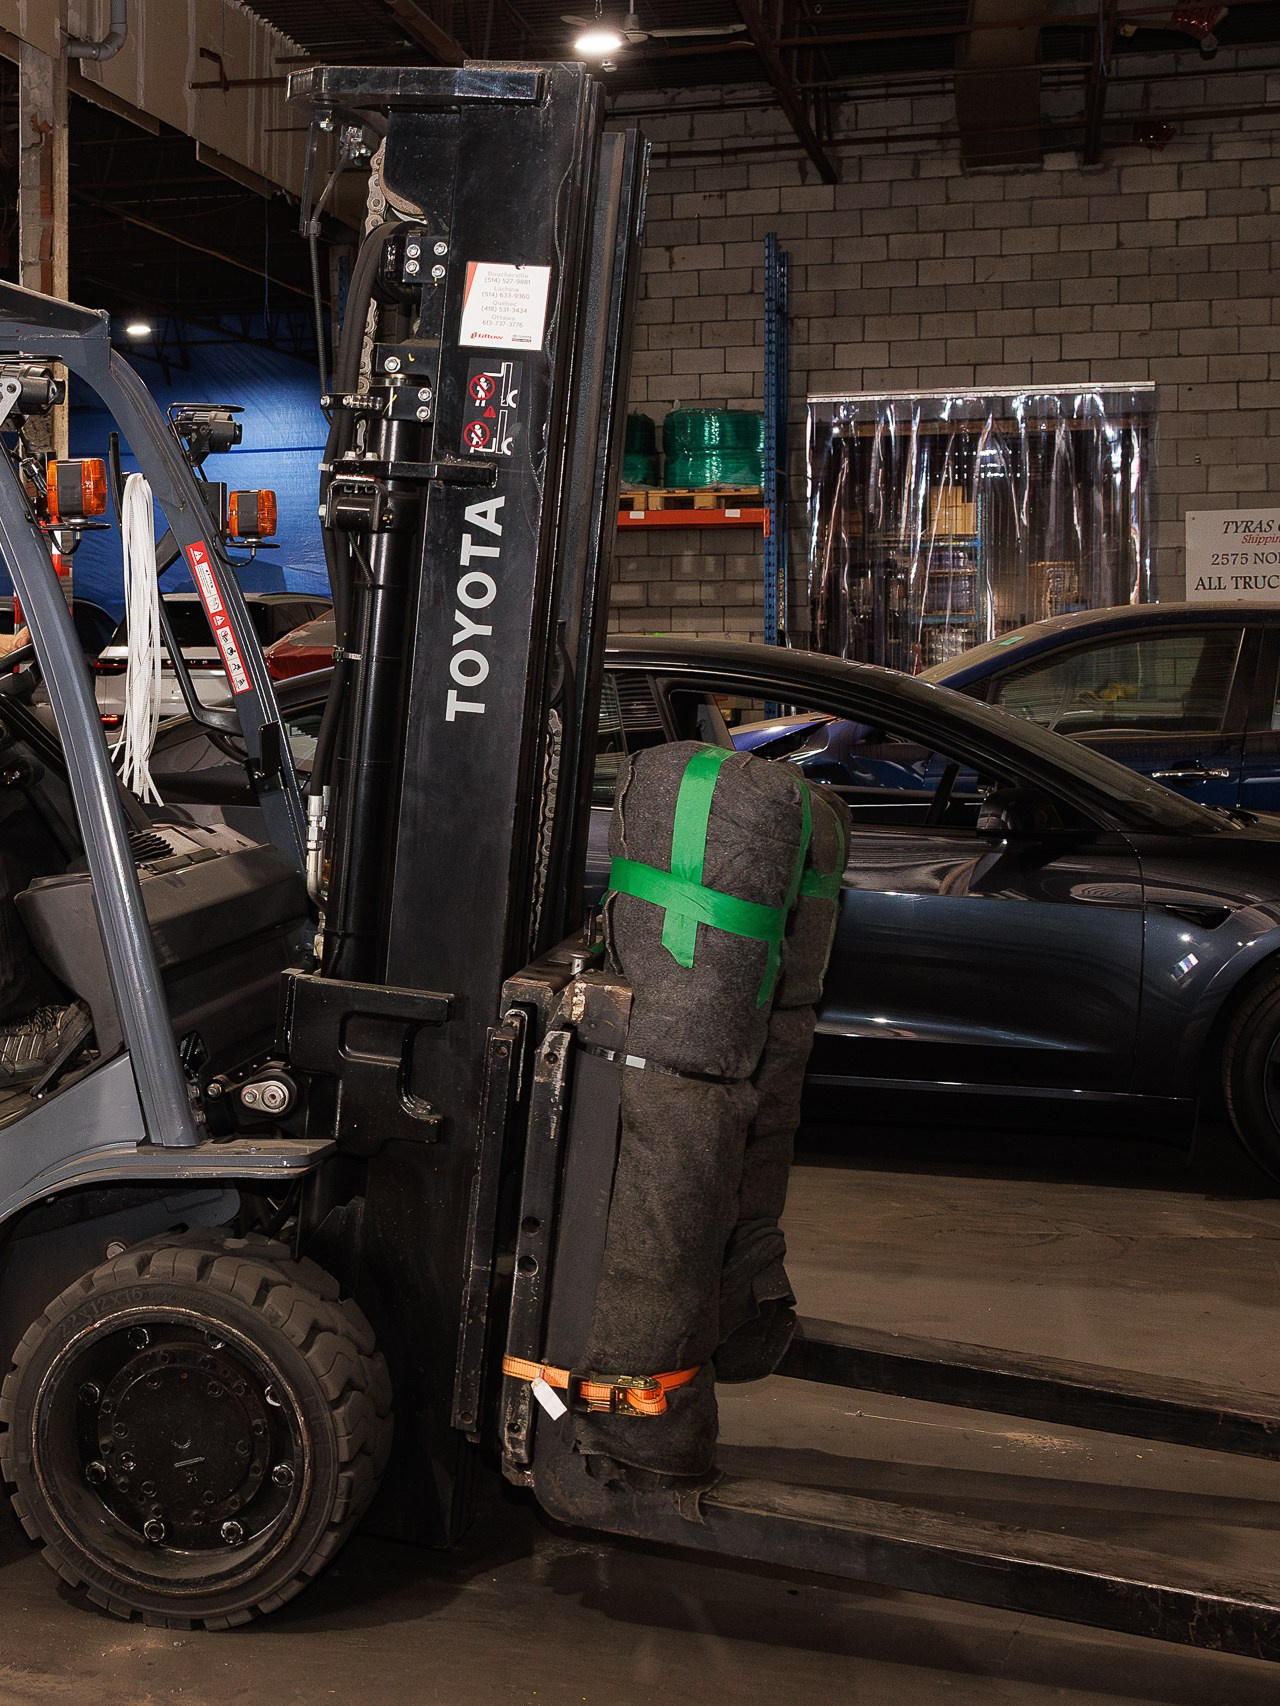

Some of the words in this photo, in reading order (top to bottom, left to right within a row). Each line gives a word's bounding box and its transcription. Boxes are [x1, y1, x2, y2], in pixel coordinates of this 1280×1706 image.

[1222, 519, 1275, 534] TYRAS
[1211, 552, 1249, 566] 2575
[1253, 551, 1280, 565] NO
[1194, 576, 1227, 591] ALL
[1230, 574, 1280, 590] TRUC
[445, 495, 506, 722] TOYOTA
